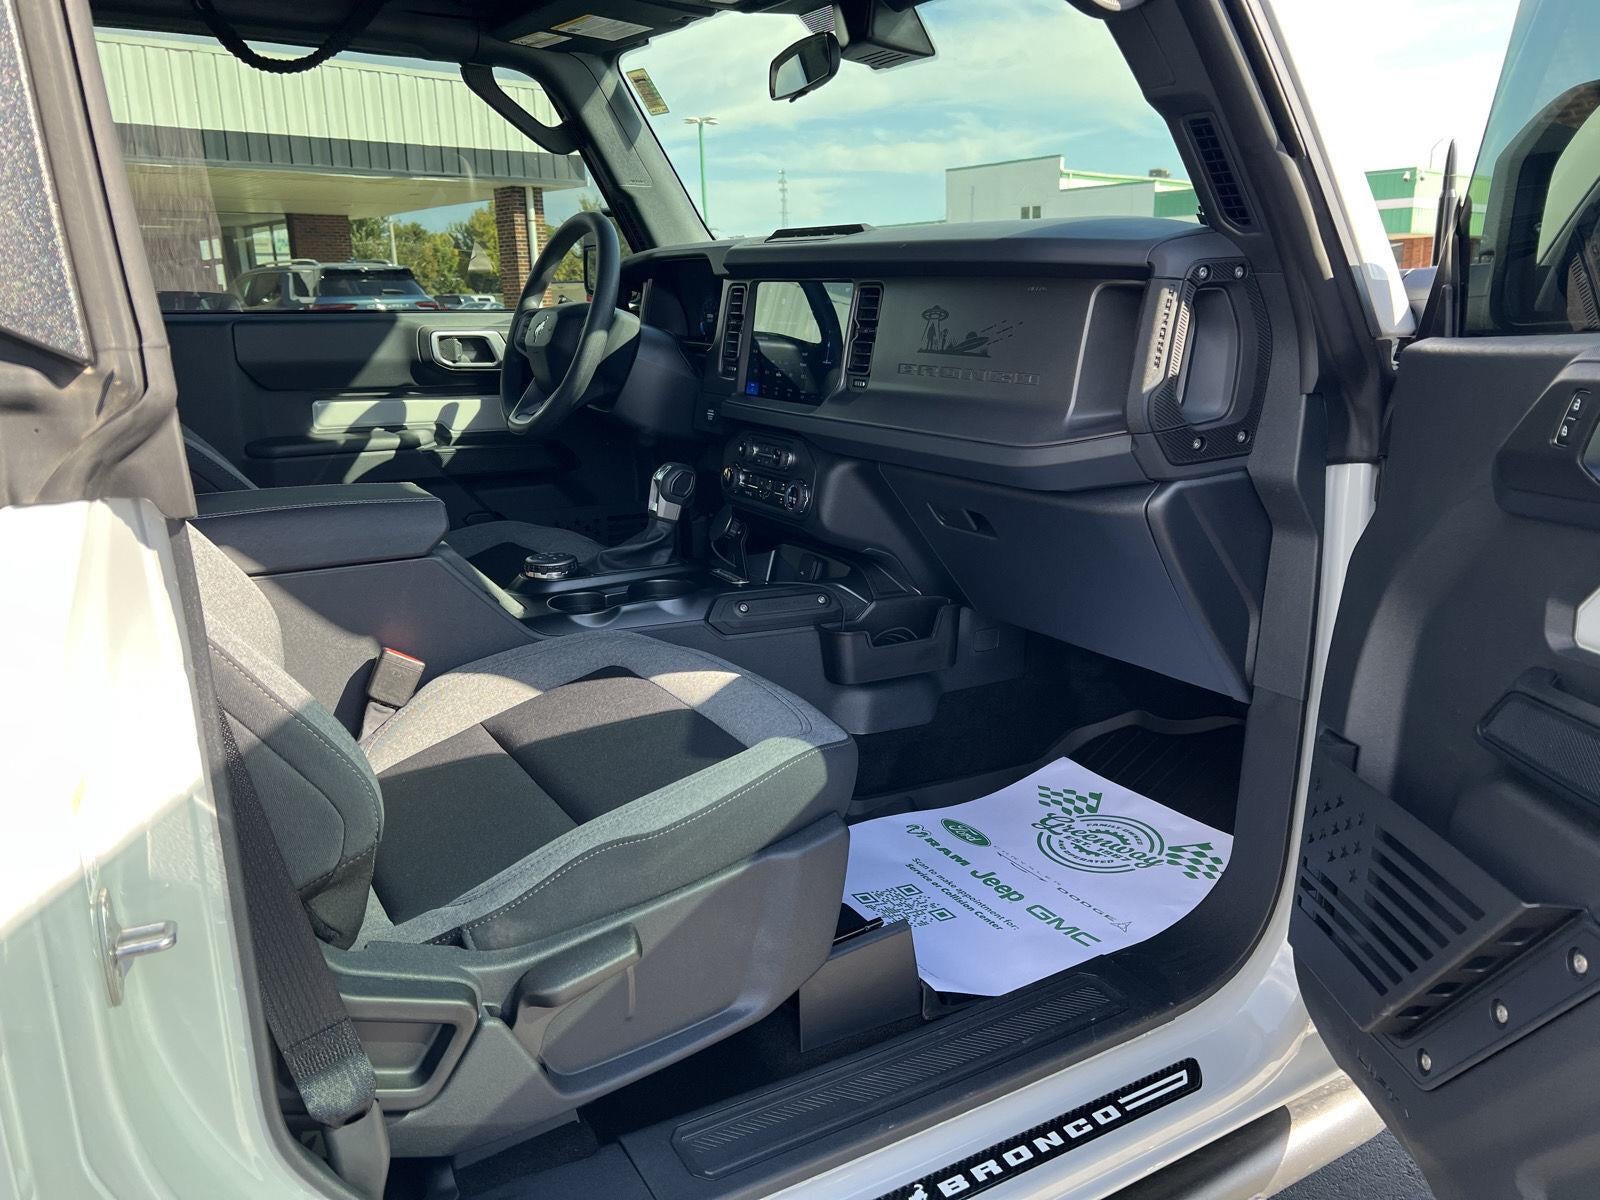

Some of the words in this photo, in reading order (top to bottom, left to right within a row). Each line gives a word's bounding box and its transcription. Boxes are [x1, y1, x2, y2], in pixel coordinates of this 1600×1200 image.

[1031, 812, 1165, 869] Greenway
[1086, 823, 1121, 831] FAMILY
[924, 837, 971, 867] RAM
[905, 863, 933, 882] Service
[941, 887, 975, 912] Collision
[974, 911, 1004, 930] Center
[912, 857, 930, 871] Scan
[936, 874, 957, 889] make
[955, 887, 1005, 920] appointment
[970, 869, 1025, 902] Jeep
[1057, 887, 1117, 922] DODGE
[1025, 904, 1102, 947] GMC
[936, 1105, 1122, 1199] BRONCO
